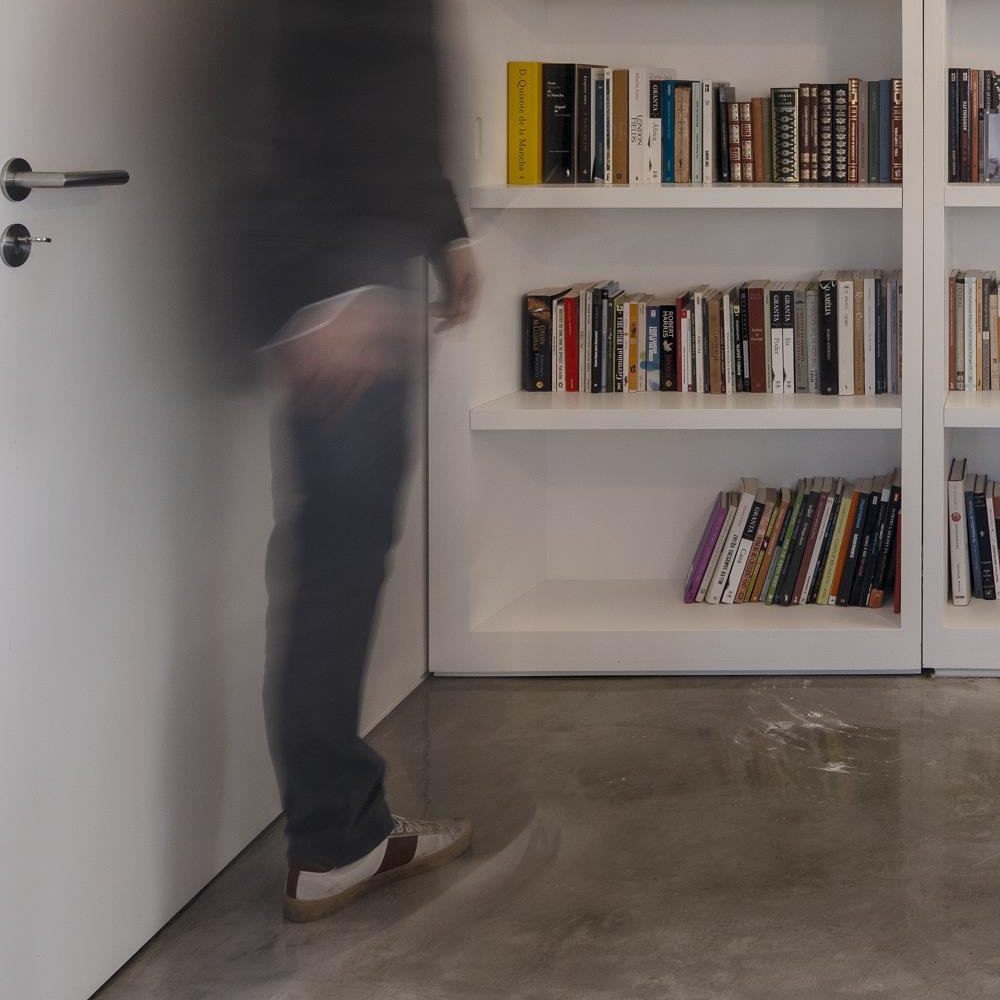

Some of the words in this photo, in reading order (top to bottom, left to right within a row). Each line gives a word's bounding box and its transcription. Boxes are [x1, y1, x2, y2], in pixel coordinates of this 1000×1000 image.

[517, 79, 527, 114] Quixote
[519, 116, 527, 125] de
[519, 128, 527, 136] la
[636, 114, 644, 146] LONDON
[519, 139, 527, 171] Mancha
[824, 292, 832, 316] AMÉLIA
[747, 506, 760, 534] GRANTA
